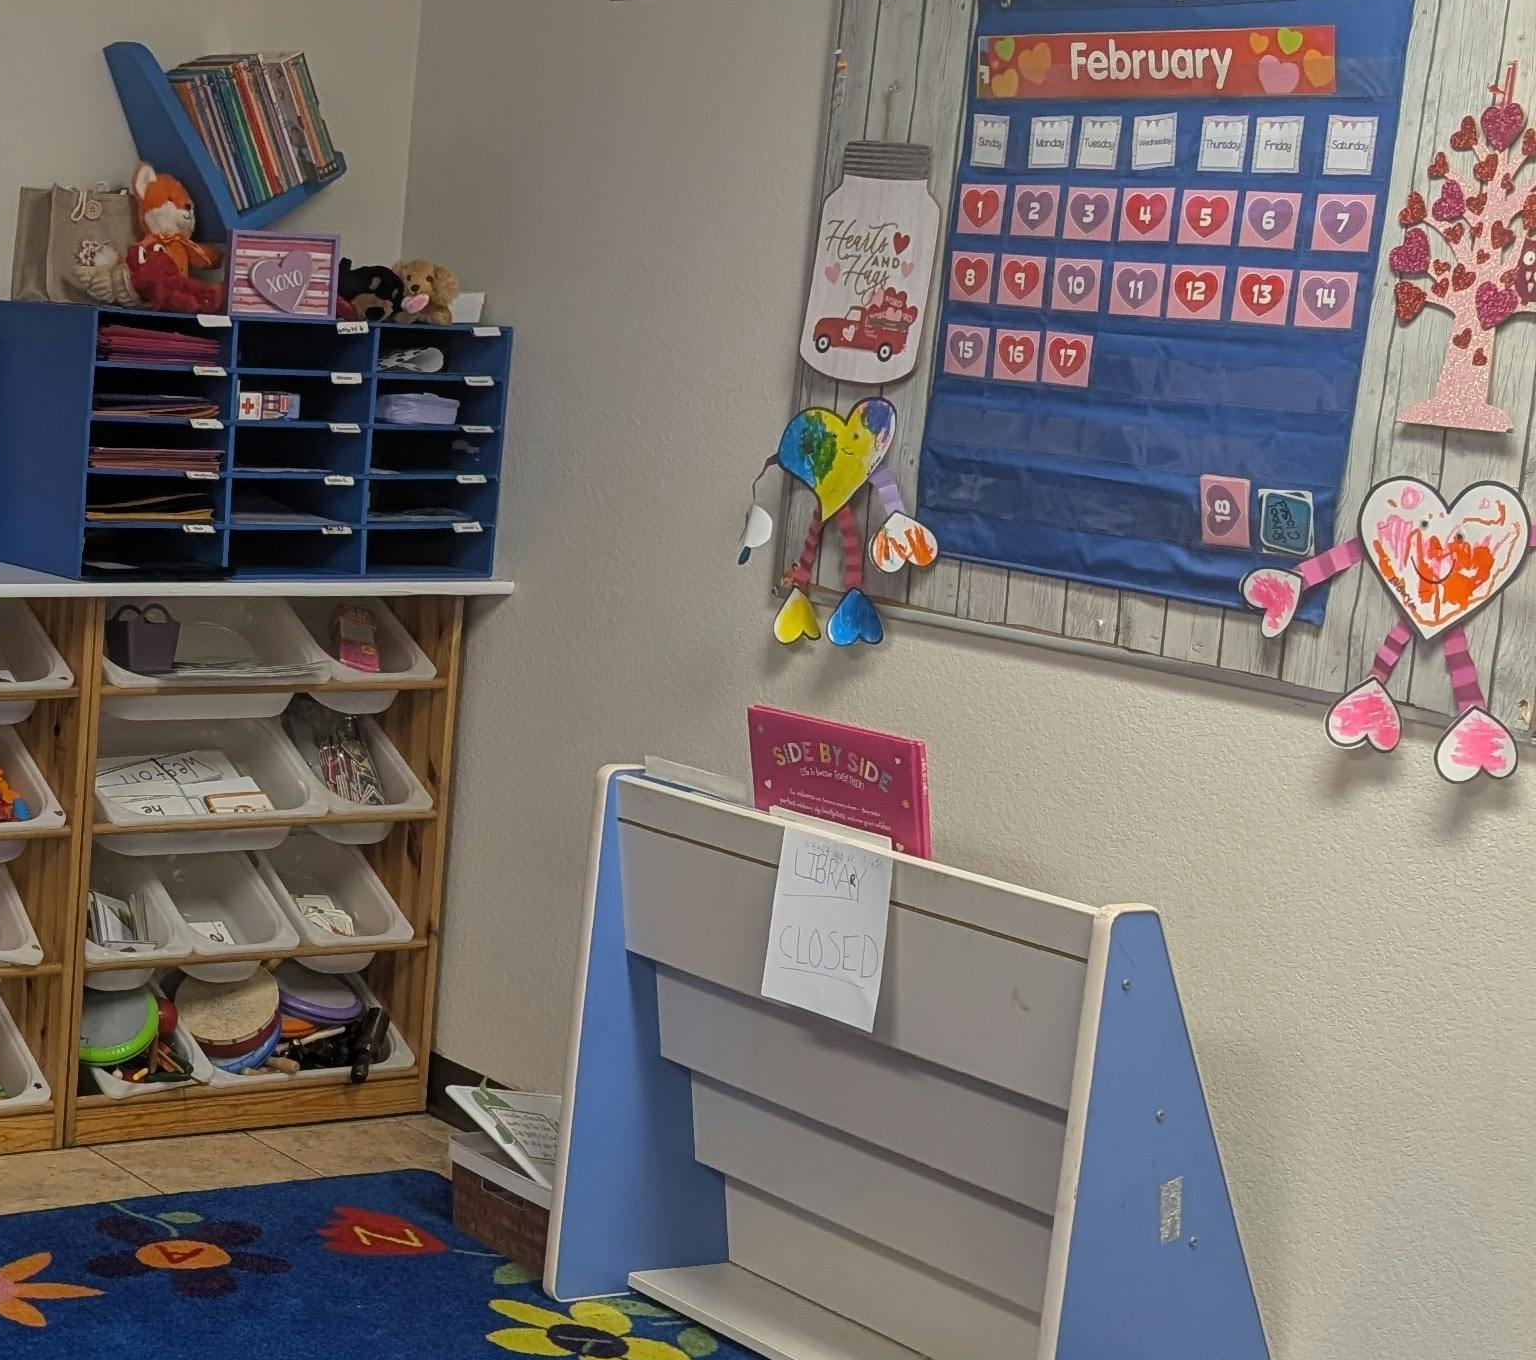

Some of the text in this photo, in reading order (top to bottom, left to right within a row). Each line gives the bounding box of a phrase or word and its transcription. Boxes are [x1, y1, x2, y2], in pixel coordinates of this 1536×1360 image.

[1070, 39, 1233, 90] February
[978, 138, 1002, 150] Sunday
[1035, 138, 1065, 150] Monday
[1083, 138, 1115, 151] Tuesday
[1205, 139, 1241, 151] Thursday
[1264, 140, 1292, 153] Friday
[1331, 140, 1370, 152] Saturday
[976, 200, 1350, 233] 1 2 3 4 5 6 7
[825, 220, 898, 260] Hearts
[871, 256, 900, 269] AND
[266, 270, 303, 294] XOXO
[965, 269, 1336, 309] 8 9 10 11 12 13 14
[958, 341, 1077, 367] 15 16 17
[1215, 499, 1232, 522] 18
[772, 741, 814, 767] SIDE
[819, 742, 842, 768] BY
[794, 847, 867, 901] LIBRARY
[779, 925, 879, 978] CLOSED
[154, 1244, 205, 1266] A
